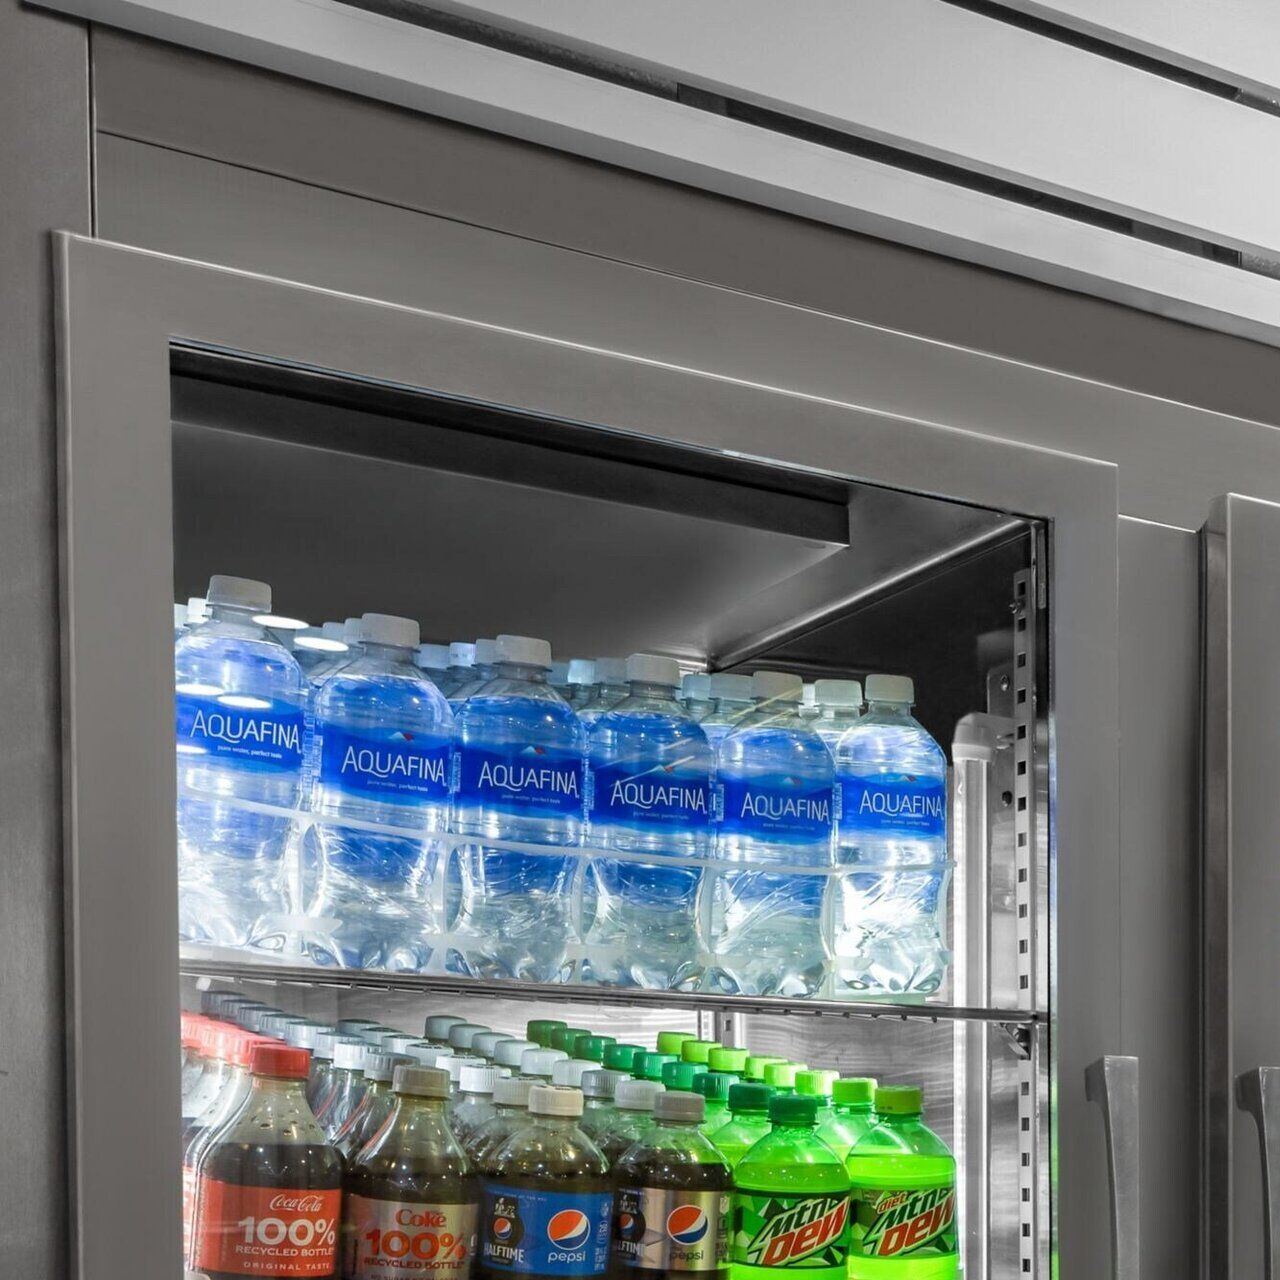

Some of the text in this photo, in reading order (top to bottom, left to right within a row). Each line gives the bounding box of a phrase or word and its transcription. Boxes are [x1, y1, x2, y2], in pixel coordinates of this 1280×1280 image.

[190, 709, 301, 753] AQUAFINA
[341, 746, 447, 787] AQUAFINA
[478, 761, 579, 798] AQUAFINA
[611, 781, 707, 814] AQUAFINA
[741, 792, 831, 824] AQUAFINA
[860, 790, 944, 820] AQUAFINA
[237, 1216, 335, 1245] 100%
[396, 1209, 447, 1228] Coke
[365, 1228, 465, 1260] 100%
[548, 1251, 586, 1263] pepsi
